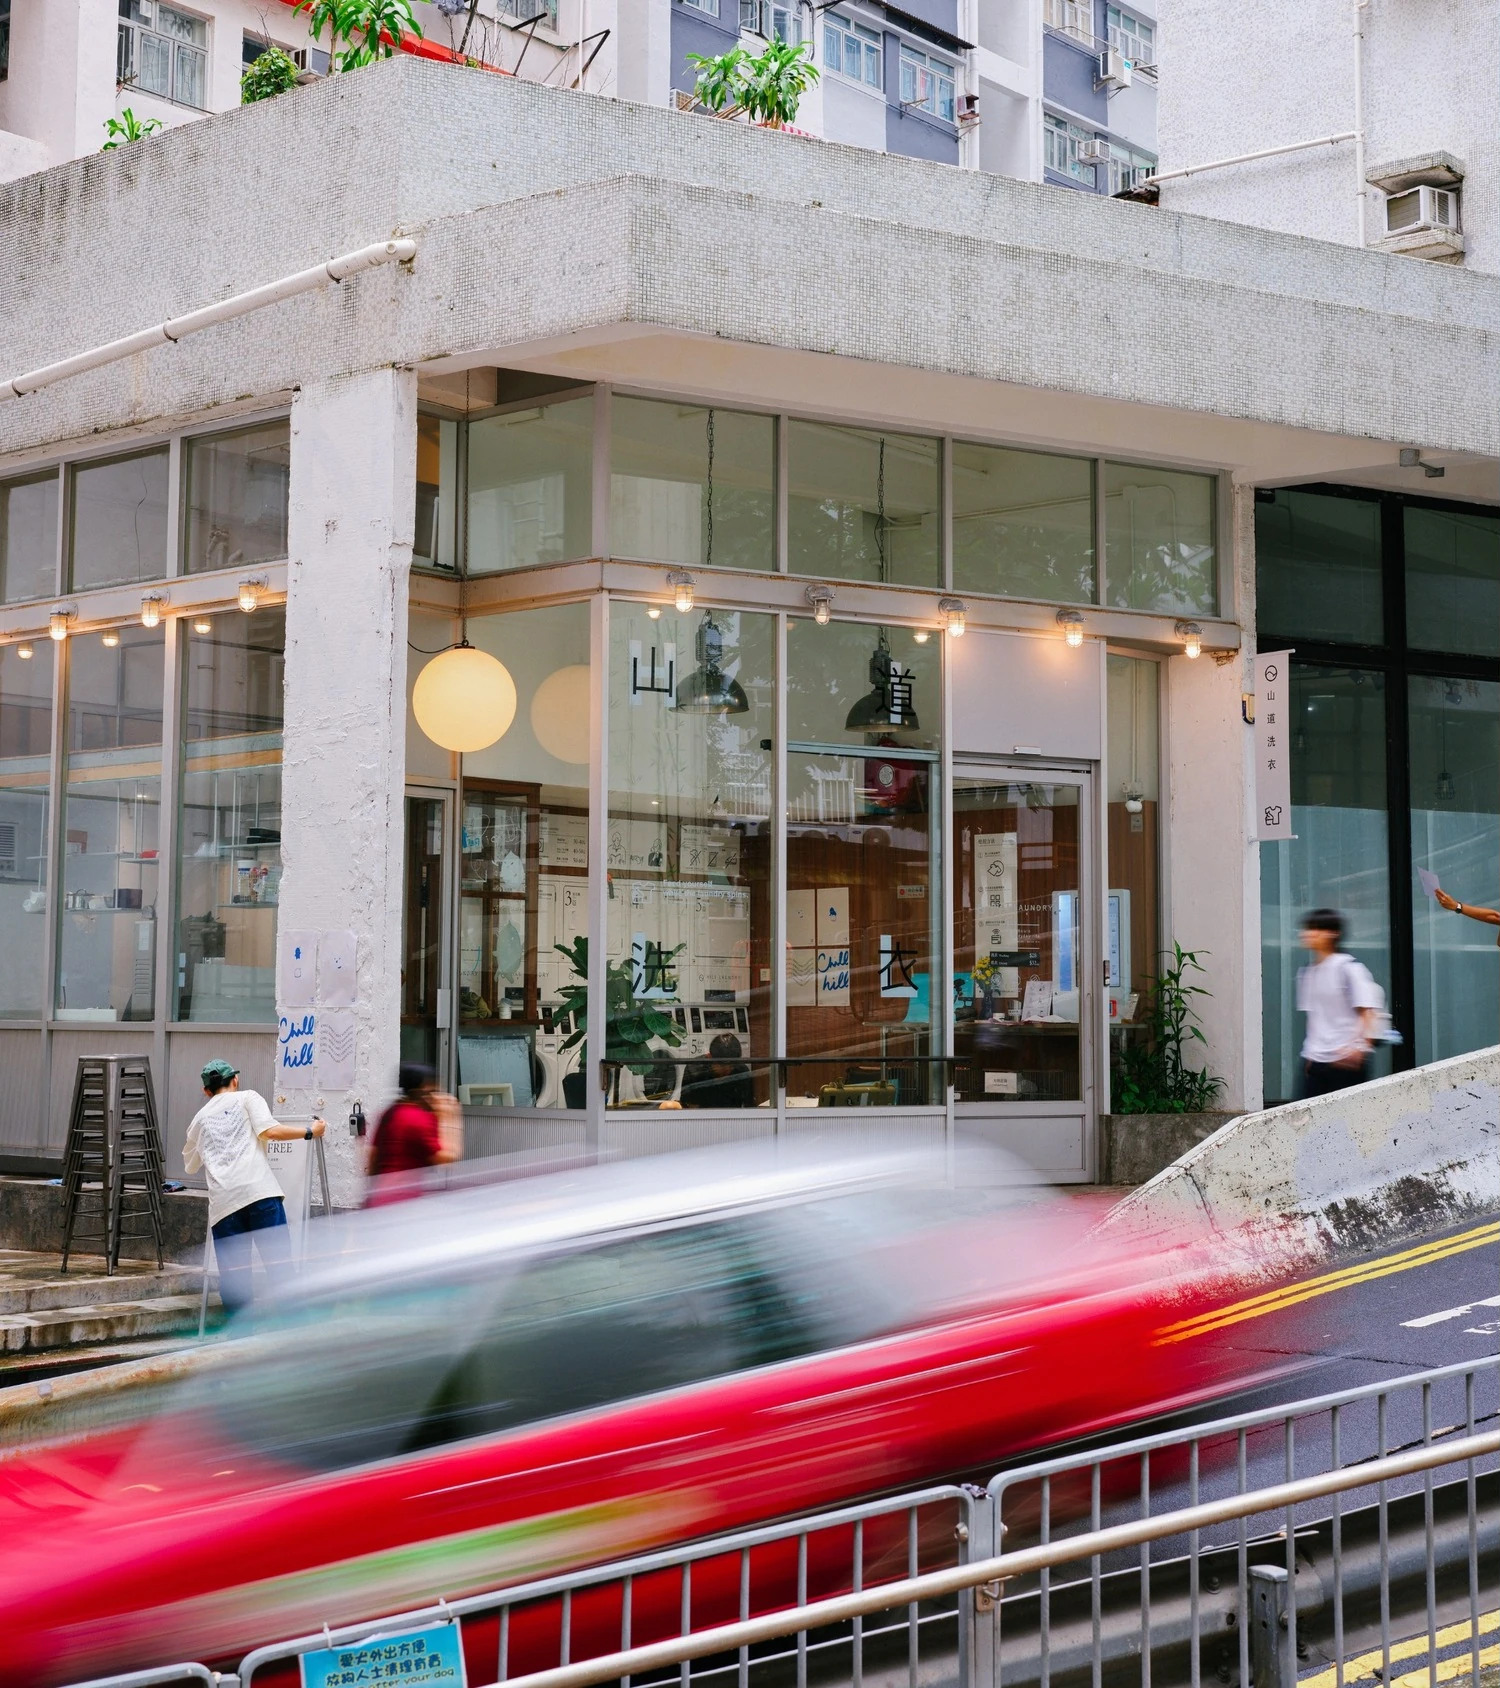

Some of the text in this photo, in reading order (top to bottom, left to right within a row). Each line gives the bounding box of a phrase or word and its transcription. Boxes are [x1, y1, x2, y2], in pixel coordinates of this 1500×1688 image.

[632, 646, 674, 698] 山
[875, 667, 917, 717] 道
[1266, 689, 1277, 771] 山道洗衣
[1016, 904, 1053, 912] AUNDRY
[631, 941, 678, 995] 洗
[878, 941, 919, 992] 衣
[279, 1015, 315, 1044] Chill
[283, 1042, 313, 1068] hill
[267, 1142, 293, 1154] FREE
[340, 1638, 426, 1668] 愛犬外出方便
[326, 1653, 442, 1687] 放狗人士清理有責
[404, 1673, 431, 1685] your
